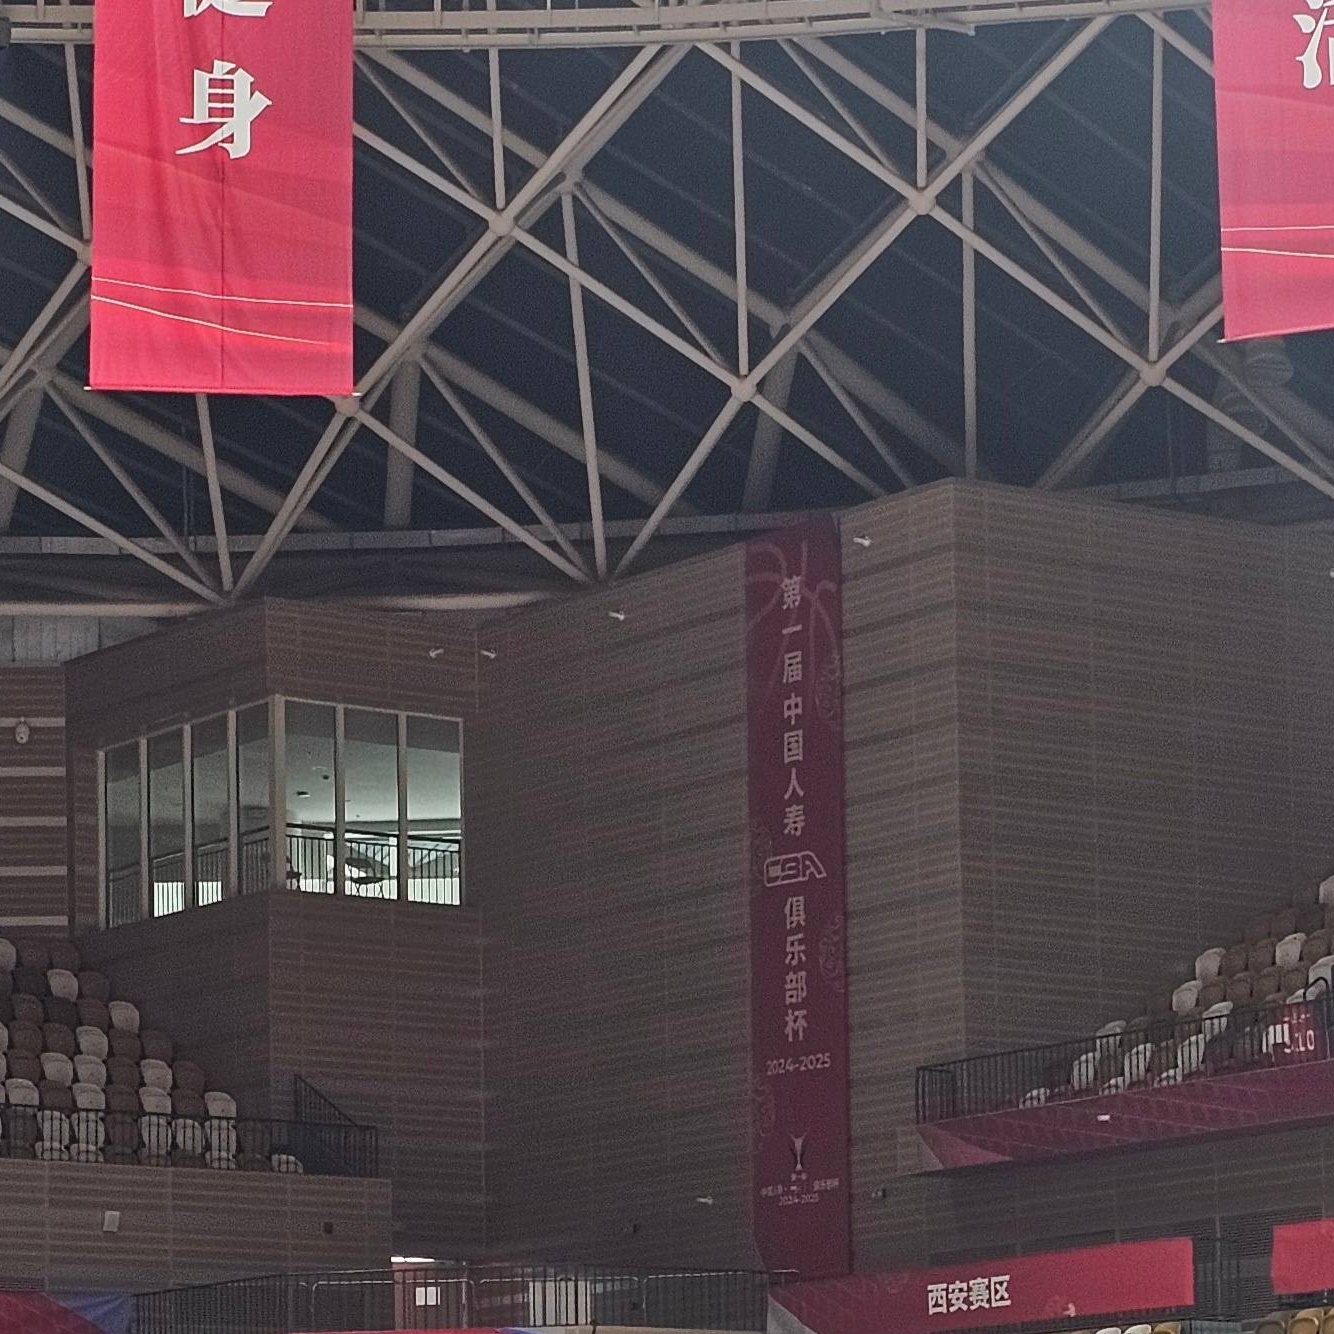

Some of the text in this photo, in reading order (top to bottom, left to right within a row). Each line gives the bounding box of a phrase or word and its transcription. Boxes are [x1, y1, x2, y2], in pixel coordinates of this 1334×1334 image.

[175, 0, 273, 159] 身
[766, 1053, 831, 1076] 2024-2025
[927, 1275, 1011, 1315] 西安赛区
